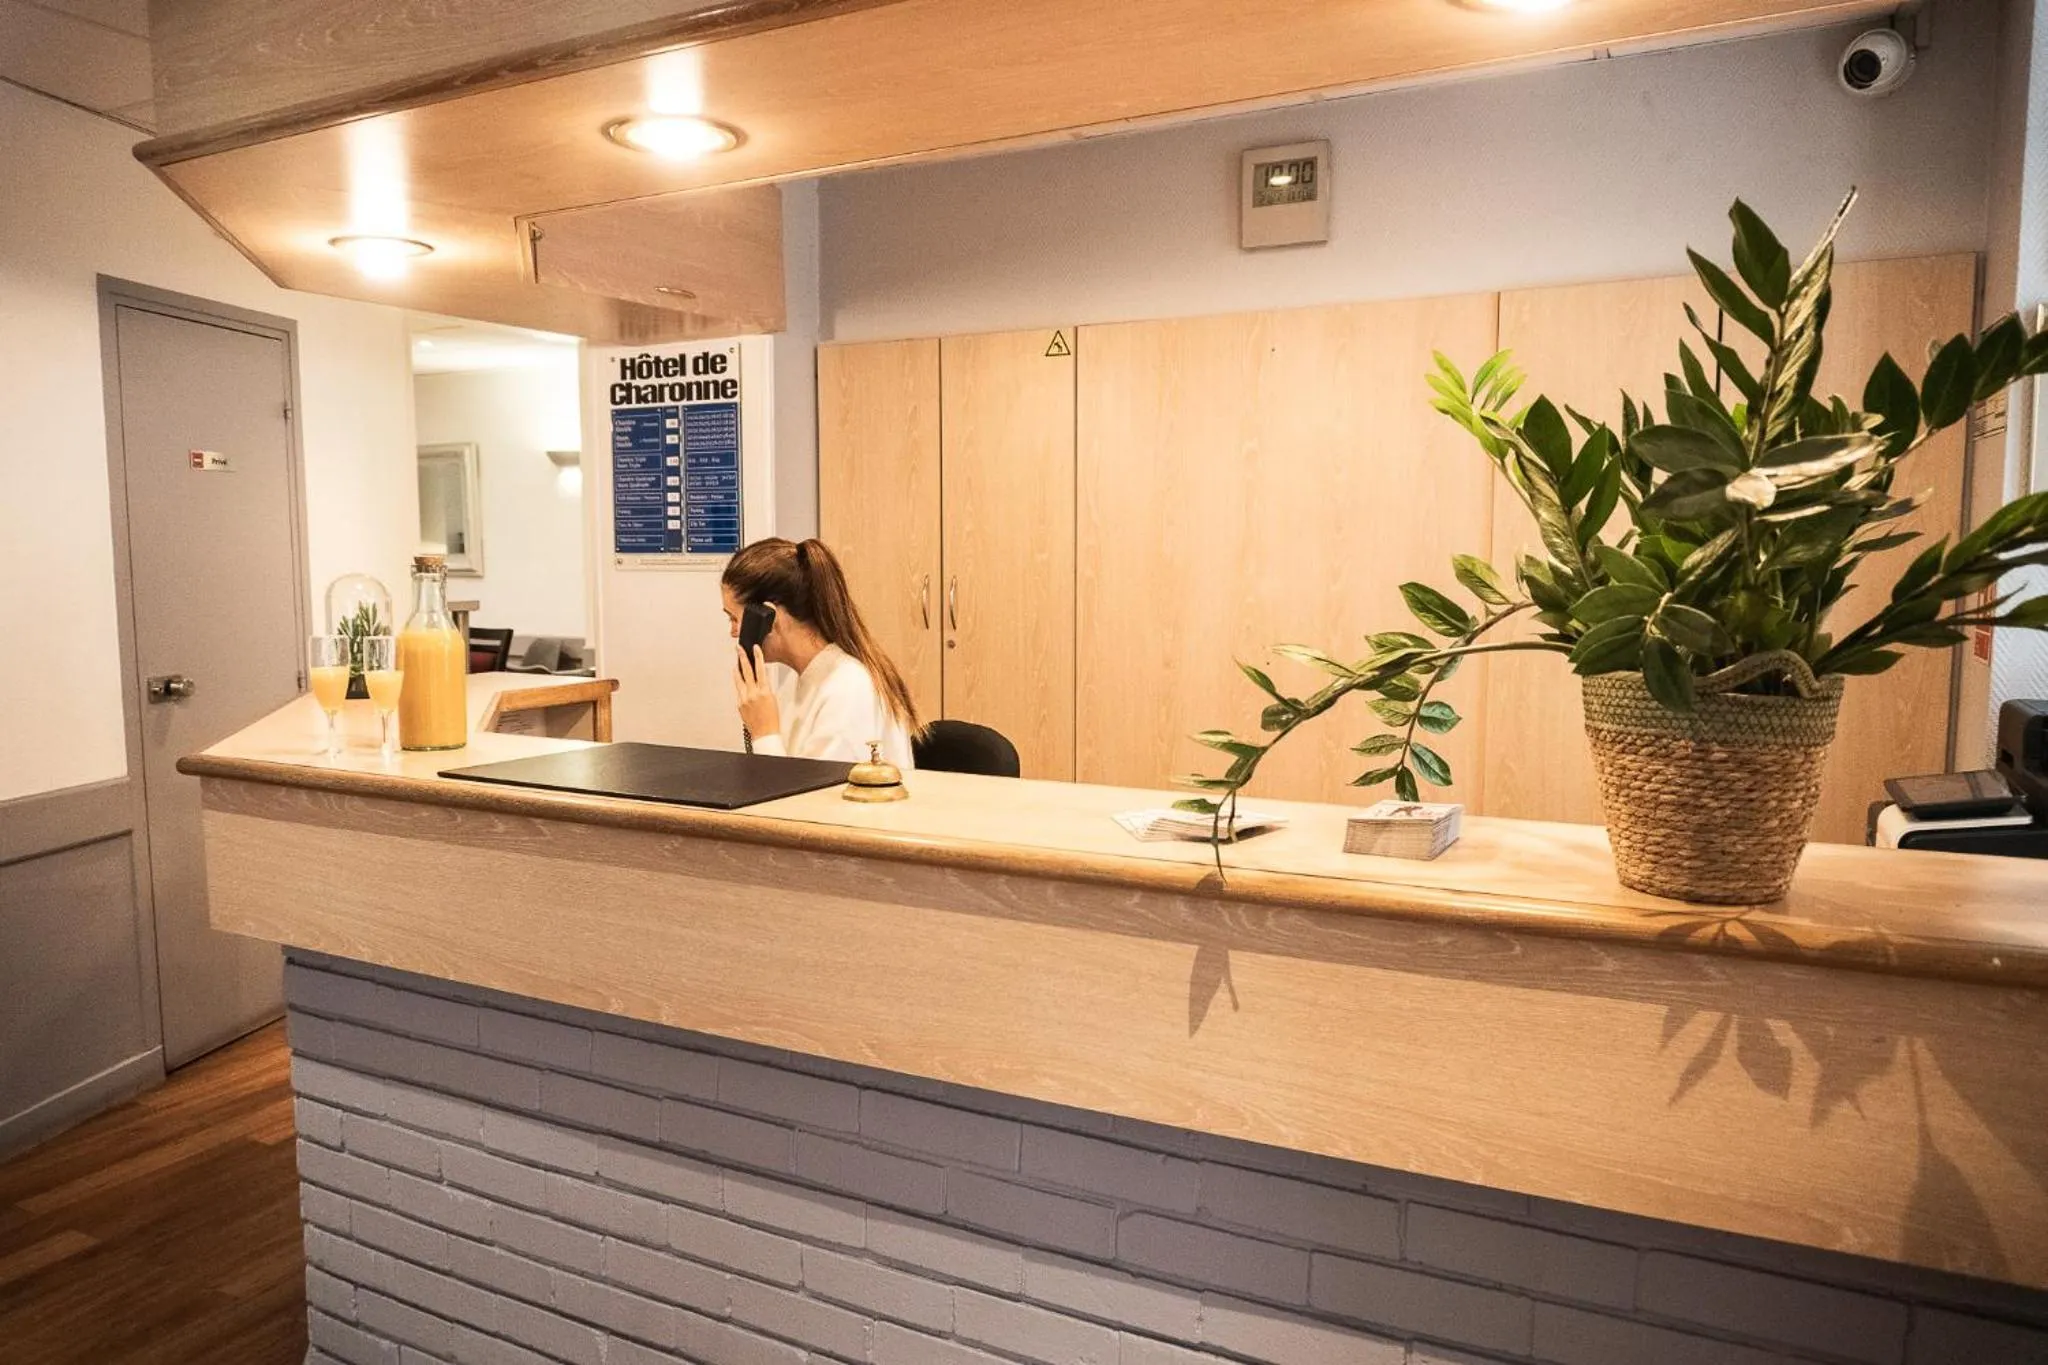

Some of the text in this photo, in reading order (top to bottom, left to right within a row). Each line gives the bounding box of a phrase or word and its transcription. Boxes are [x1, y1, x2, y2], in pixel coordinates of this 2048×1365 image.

[620, 351, 728, 380] Hôtel de
[610, 378, 738, 406] Charonne
